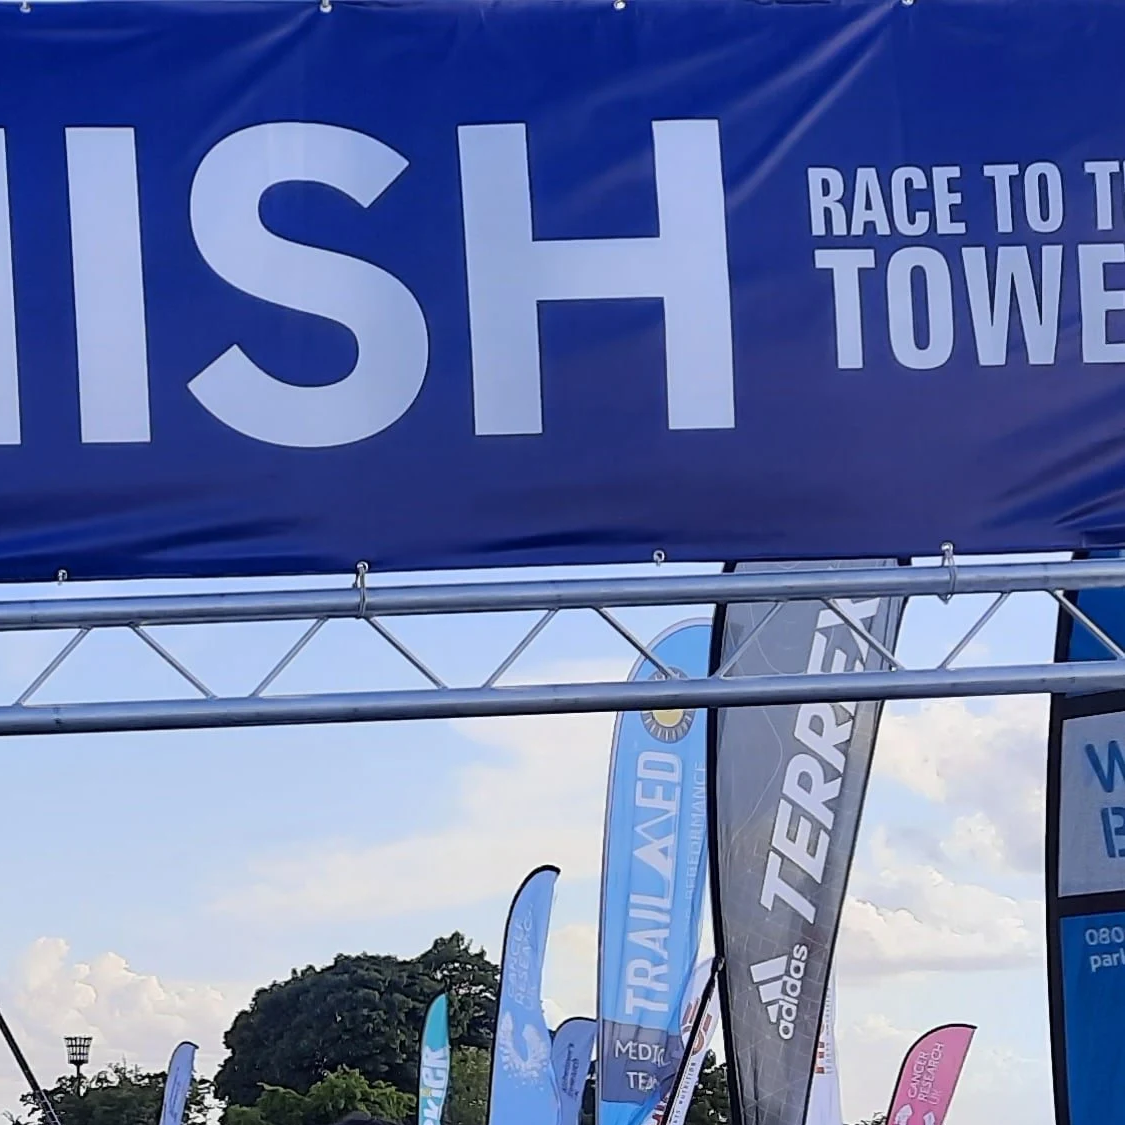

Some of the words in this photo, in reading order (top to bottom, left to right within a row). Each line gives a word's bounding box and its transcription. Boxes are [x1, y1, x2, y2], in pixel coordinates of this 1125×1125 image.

[807, 165, 966, 237] RACE
[983, 161, 1063, 233] TO
[1084, 160, 1125, 231] T
[778, 943, 809, 1041] adidas
[908, 1050, 930, 1099] CANCER
[917, 1041, 945, 1102] RESEARCH
